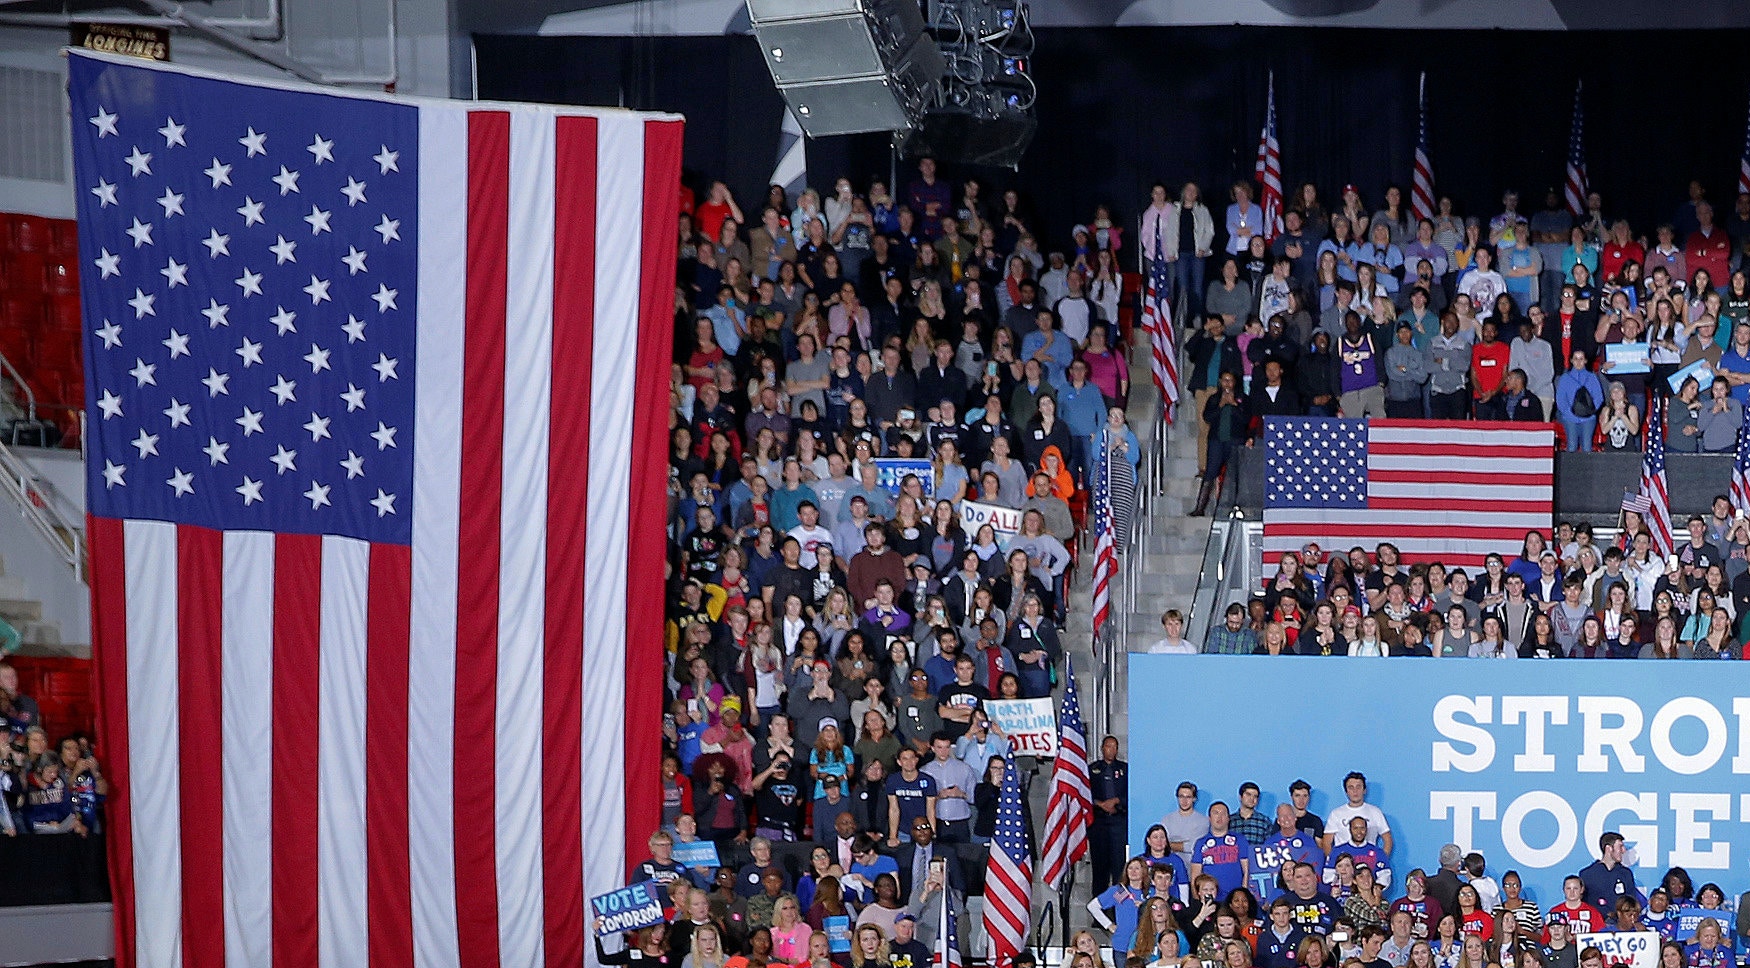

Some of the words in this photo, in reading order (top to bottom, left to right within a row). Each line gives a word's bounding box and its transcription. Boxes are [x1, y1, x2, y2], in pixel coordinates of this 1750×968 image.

[84, 33, 166, 59] LONGINES
[966, 506, 985, 522] Do
[989, 511, 1018, 530] ALL
[1008, 733, 1051, 752] OTES
[1254, 846, 1292, 869] it's
[593, 884, 651, 915] VOTE
[598, 899, 664, 934] TOMORROW
[1681, 916, 1729, 928] STROER
[1581, 937, 1623, 954] THEY
[1627, 937, 1647, 952] GO
